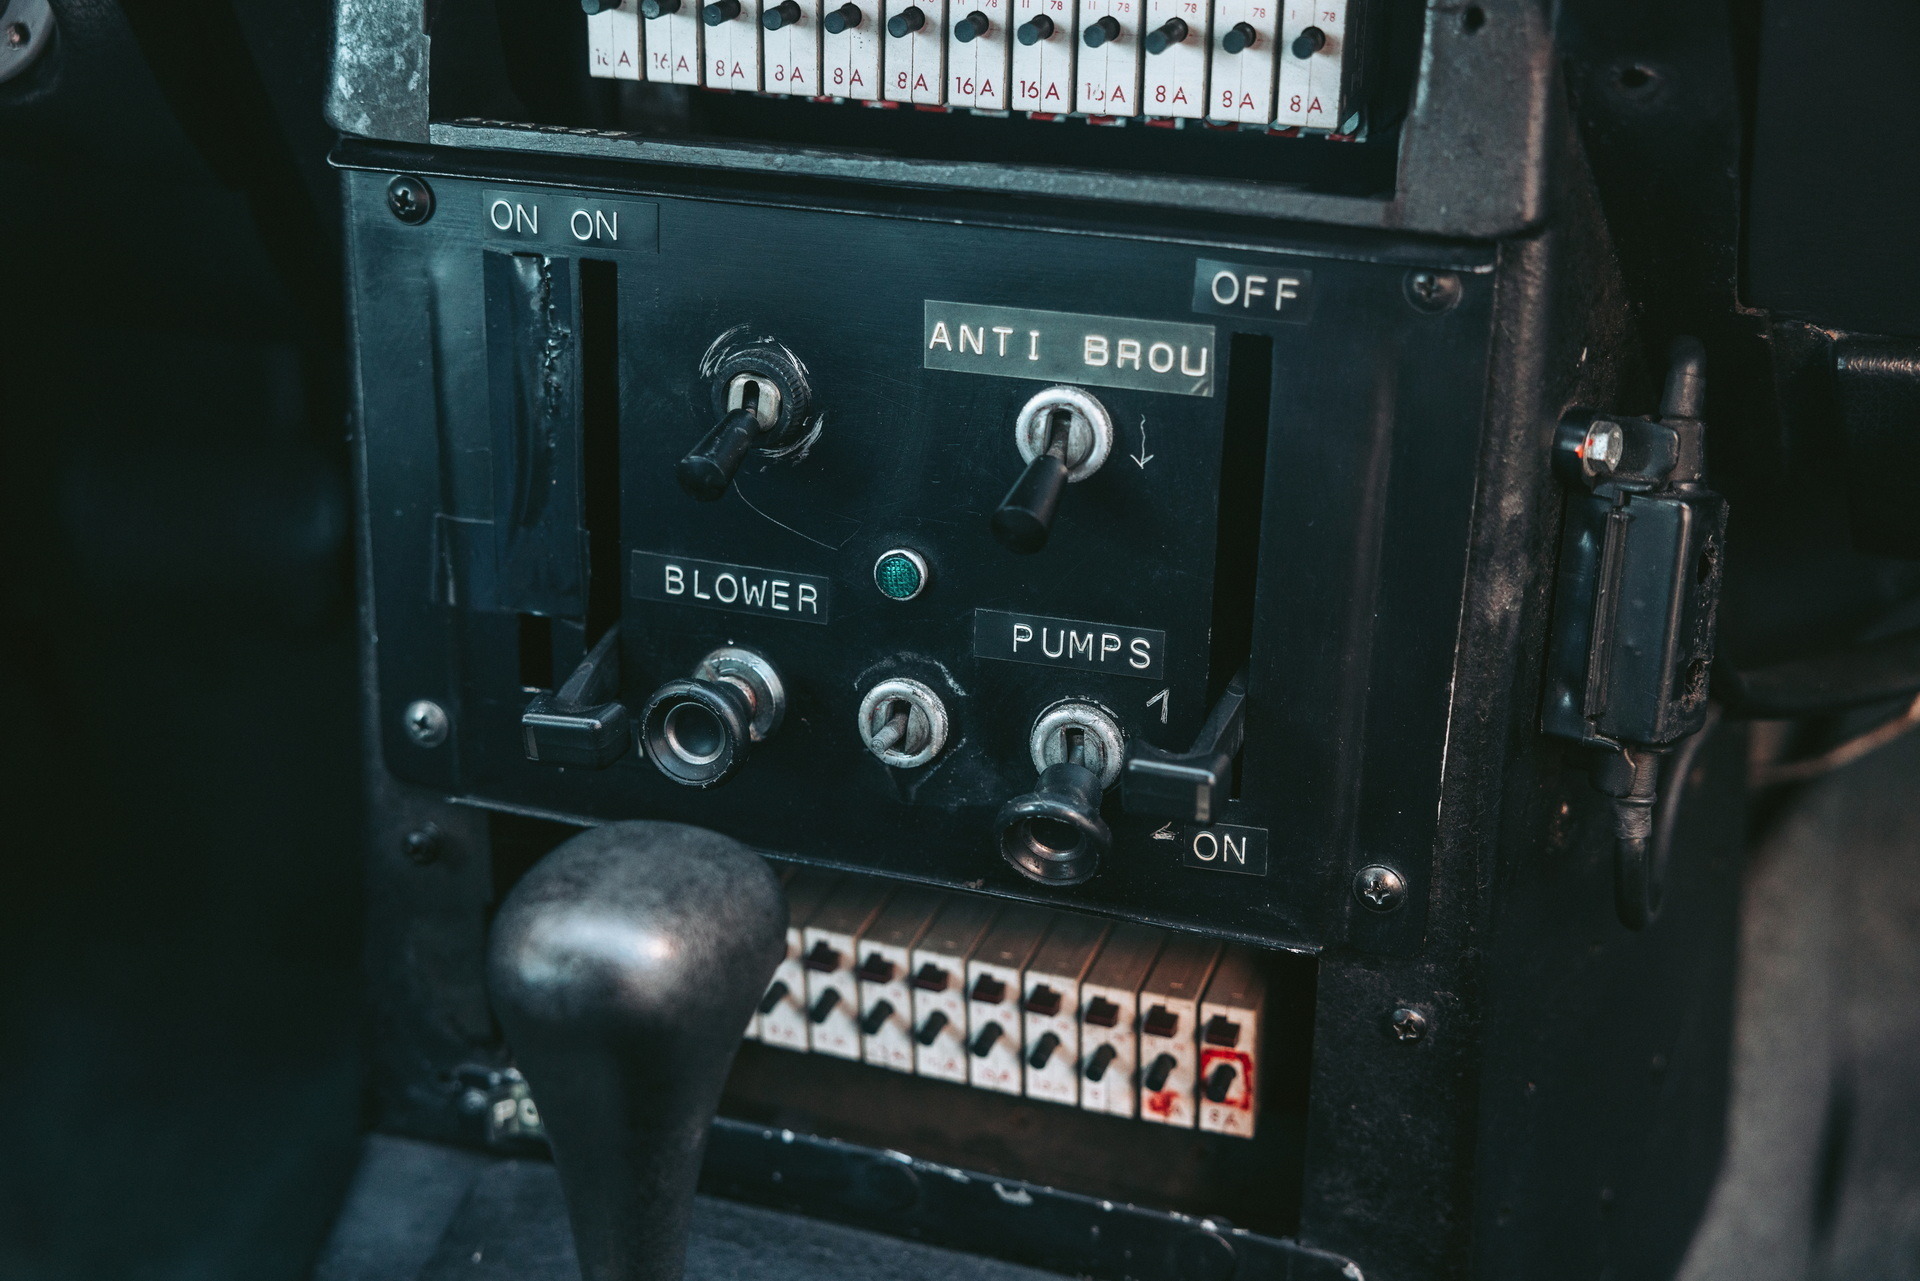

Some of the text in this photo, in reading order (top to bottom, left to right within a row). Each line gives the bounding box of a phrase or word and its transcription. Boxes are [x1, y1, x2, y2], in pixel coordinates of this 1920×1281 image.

[1050, 1, 1063, 11] 78
[1117, 3, 1130, 13] 78
[1184, 3, 1198, 13] 78
[1252, 7, 1266, 18] 78
[1322, 12, 1336, 22] 78
[955, 76, 975, 95] 16
[1020, 80, 1040, 99] 16
[489, 199, 619, 242] ON ON
[1210, 270, 1301, 312] OFF
[928, 320, 1209, 378] ANTI BROU
[664, 564, 819, 615] BLOWER
[1012, 623, 1152, 670] PUMPS
[1193, 830, 1247, 865] ON
